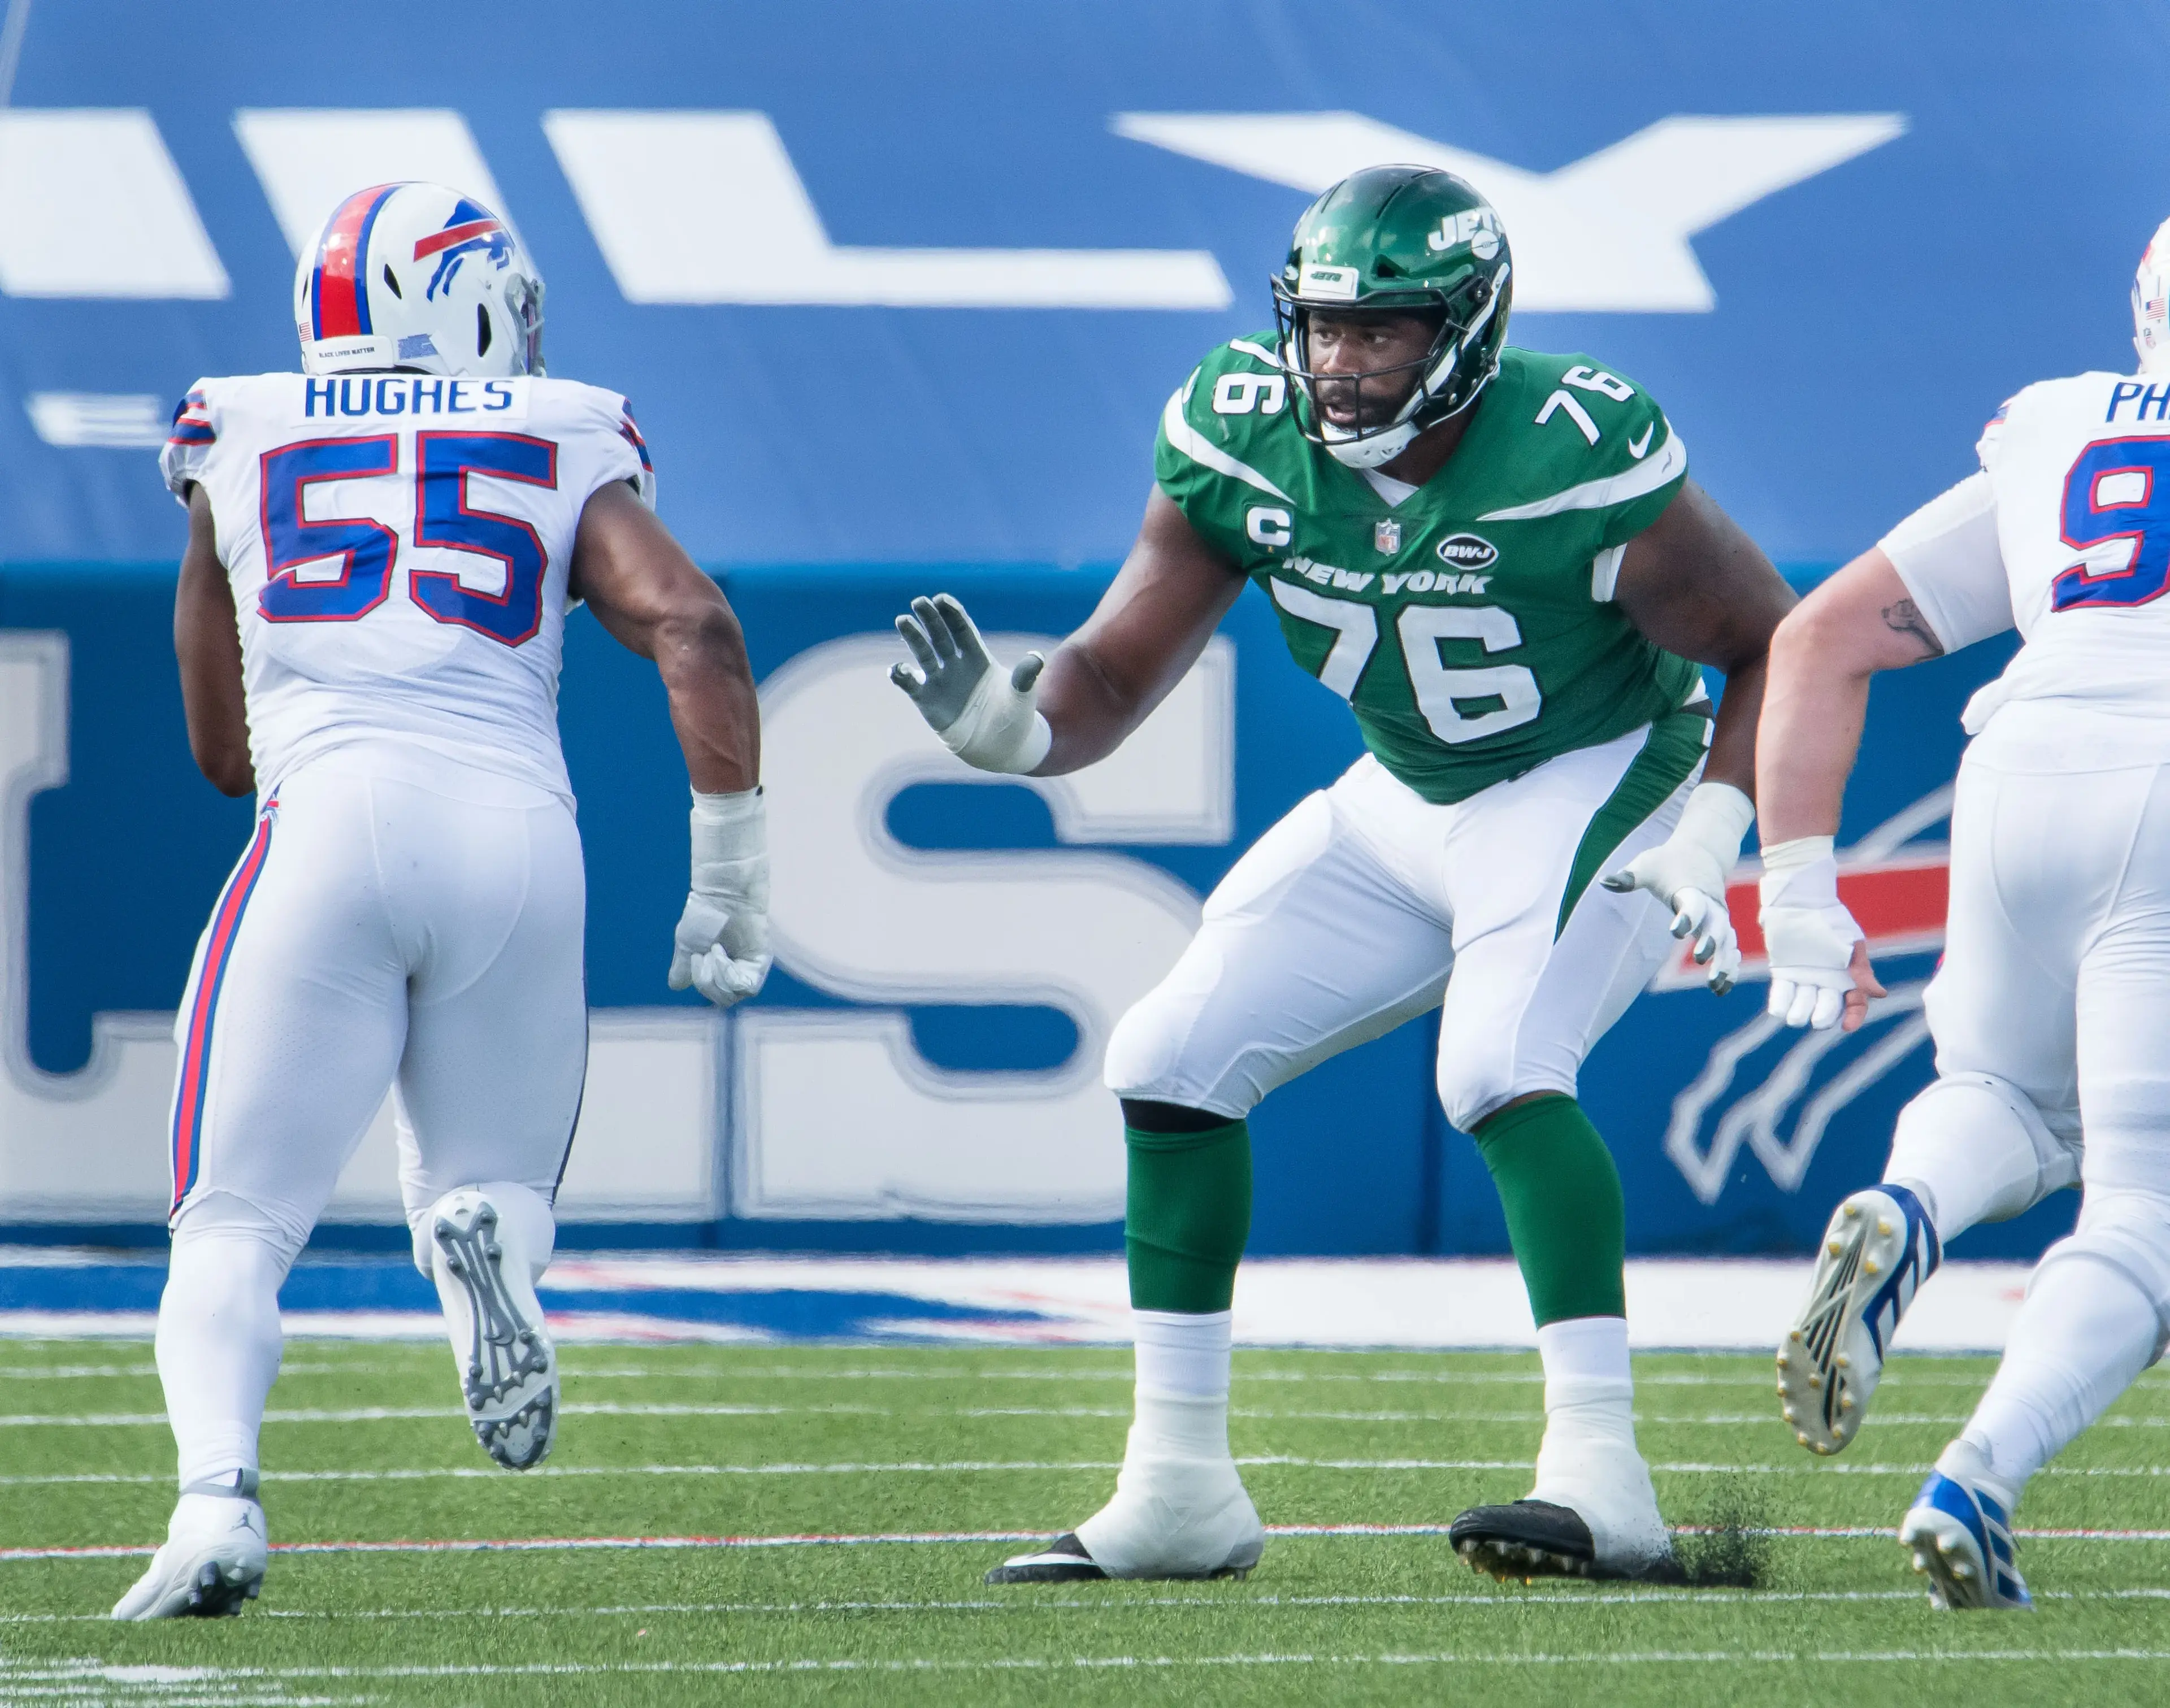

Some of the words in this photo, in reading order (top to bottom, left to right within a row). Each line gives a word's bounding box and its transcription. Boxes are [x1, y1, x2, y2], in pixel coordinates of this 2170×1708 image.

[1310, 271, 1343, 282] JETS
[351, 346, 375, 355] MATTER
[305, 377, 513, 417] HUGHES
[1533, 364, 1636, 446] 76
[2106, 381, 2170, 423] PH
[257, 429, 558, 648] 55
[1247, 506, 1290, 547] C
[1443, 544, 1492, 559] BWJ
[1282, 556, 1374, 593] NEW
[1380, 570, 1493, 596] YORK
[1269, 575, 1543, 744] 76
